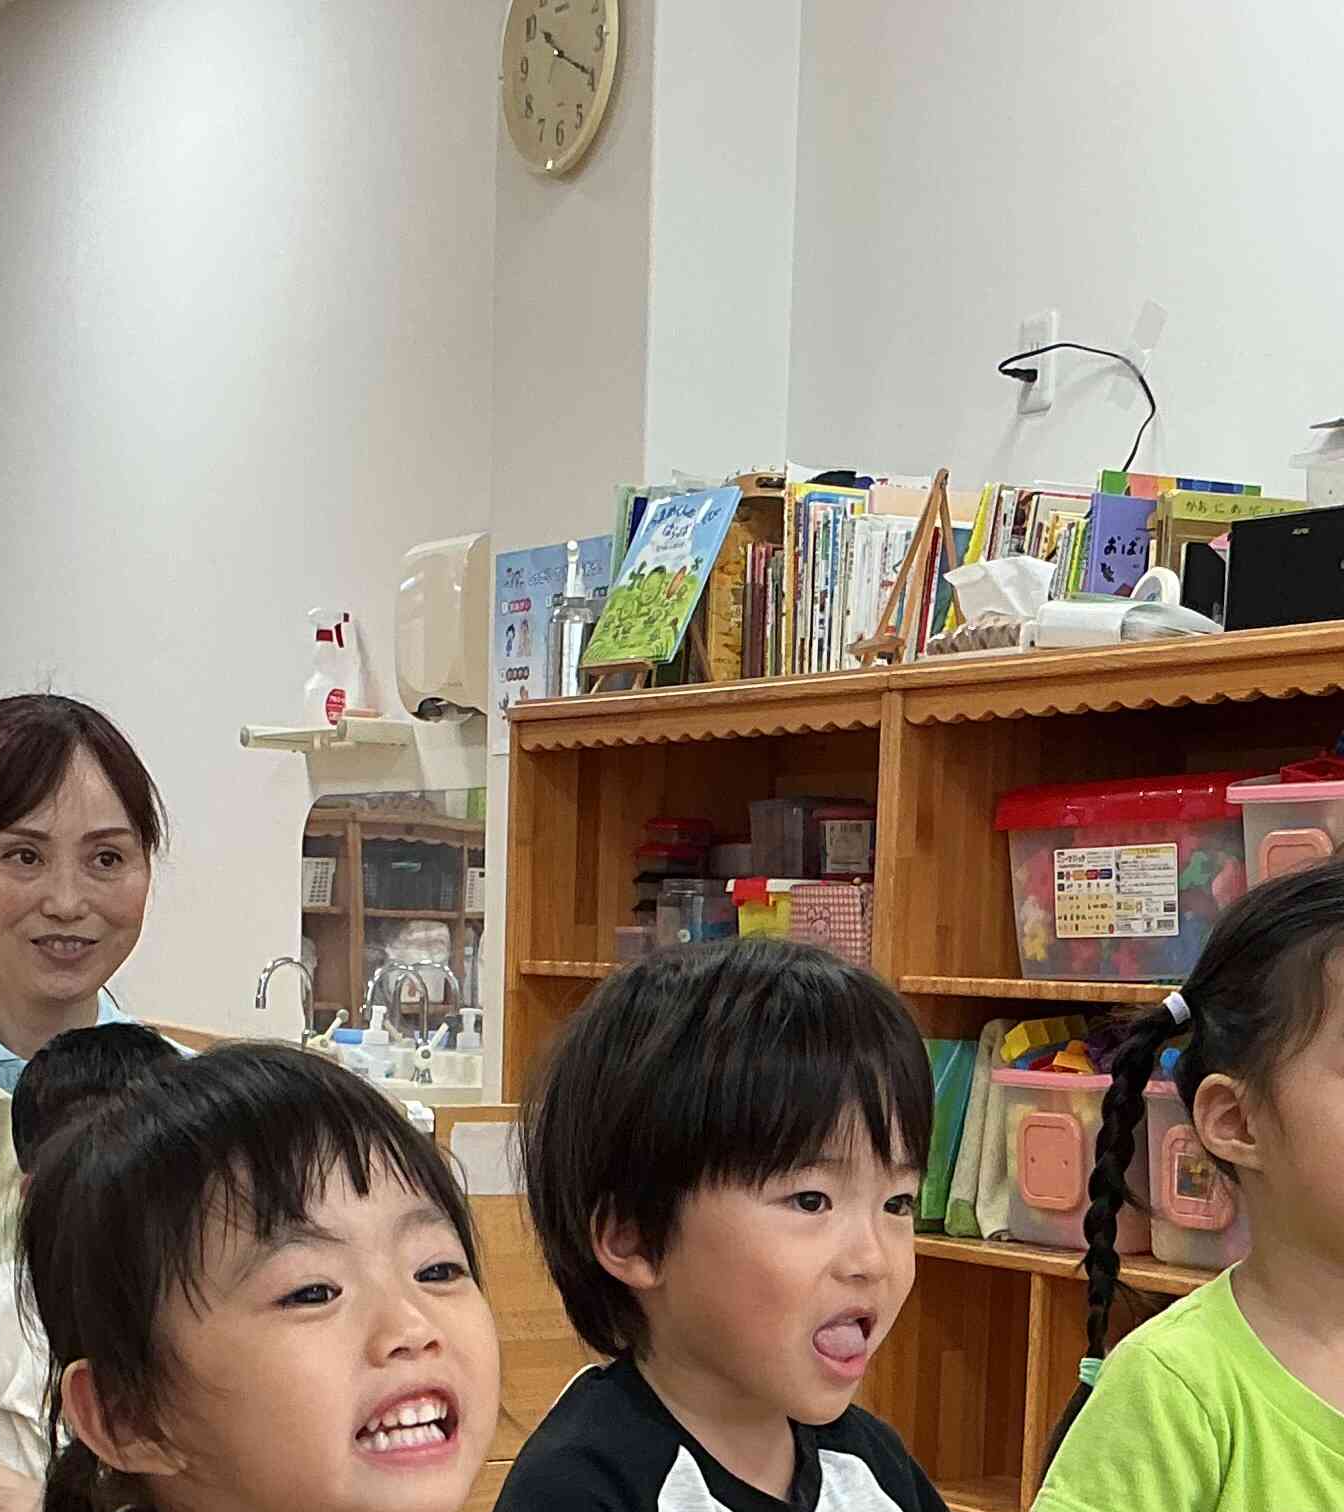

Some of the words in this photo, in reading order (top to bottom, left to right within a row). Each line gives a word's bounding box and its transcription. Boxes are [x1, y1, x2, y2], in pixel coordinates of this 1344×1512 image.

[520, 56, 529, 81] 9
[575, 103, 583, 130] 5
[537, 118, 546, 142] 7
[556, 120, 565, 146] 6
[1104, 535, 1144, 556] おば
